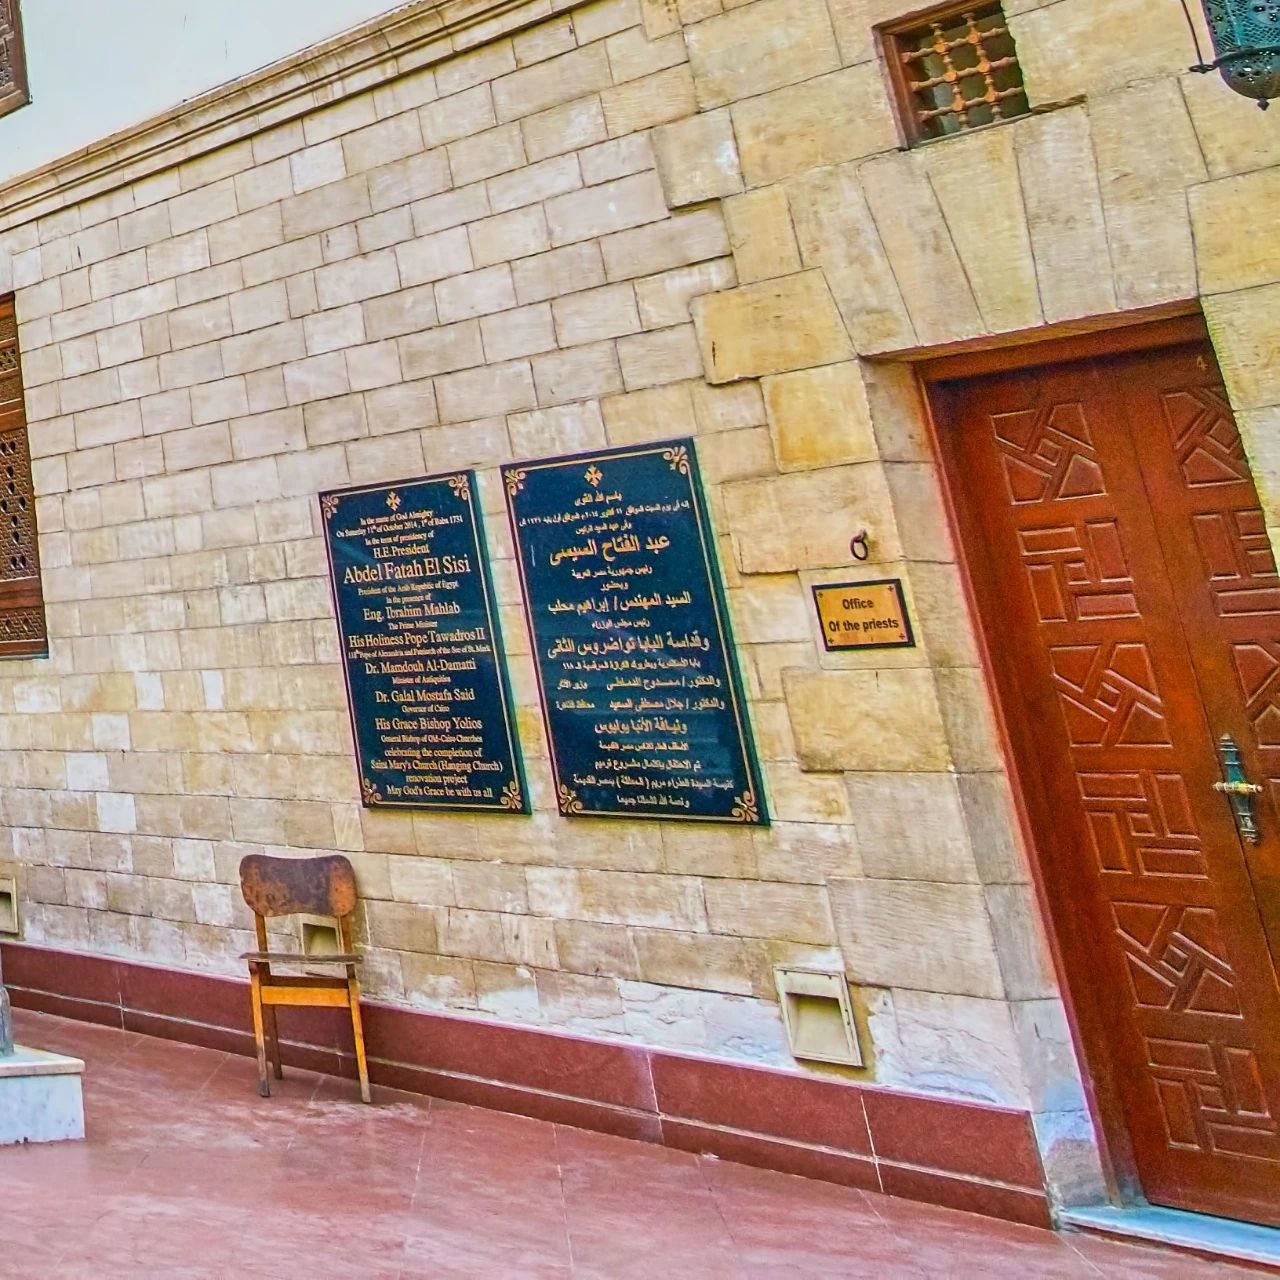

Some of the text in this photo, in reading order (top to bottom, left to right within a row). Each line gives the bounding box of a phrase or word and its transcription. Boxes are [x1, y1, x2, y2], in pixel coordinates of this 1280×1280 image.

[391, 543, 430, 556] President
[602, 534, 640, 562] الفتاح
[646, 536, 670, 554] عبد
[344, 554, 471, 584] Abdel Fatah El Sisi
[548, 599, 575, 615] محلب
[620, 593, 662, 611] المهندس
[665, 591, 691, 608] السيد
[842, 598, 874, 609] Office
[363, 601, 460, 623] Eng. Ibrahim Mahlab
[829, 618, 899, 632] Of the priests
[348, 627, 486, 648] His Holiness Pope Tawadros II
[577, 630, 710, 656] وقداسة البابا تواضروس
[365, 663, 380, 674] Dr.
[380, 660, 424, 673] Mamdouh
[643, 678, 681, 690] ممدوح
[688, 675, 721, 688] والدكتور
[375, 688, 475, 703] Dr. Galal Mostafa Said
[610, 699, 633, 711] السعيد
[665, 698, 684, 710] جلال
[692, 697, 725, 710] والدكتور
[375, 717, 483, 732] His Grace Bishop Yolios
[594, 719, 630, 734] يوليوس
[654, 717, 688, 734] ونيافة
[371, 760, 388, 769] Saint
[388, 760, 412, 771] Mary's
[412, 760, 438, 770] Church
[595, 759, 612, 770] ترميم
[613, 758, 641, 771] مشروع
